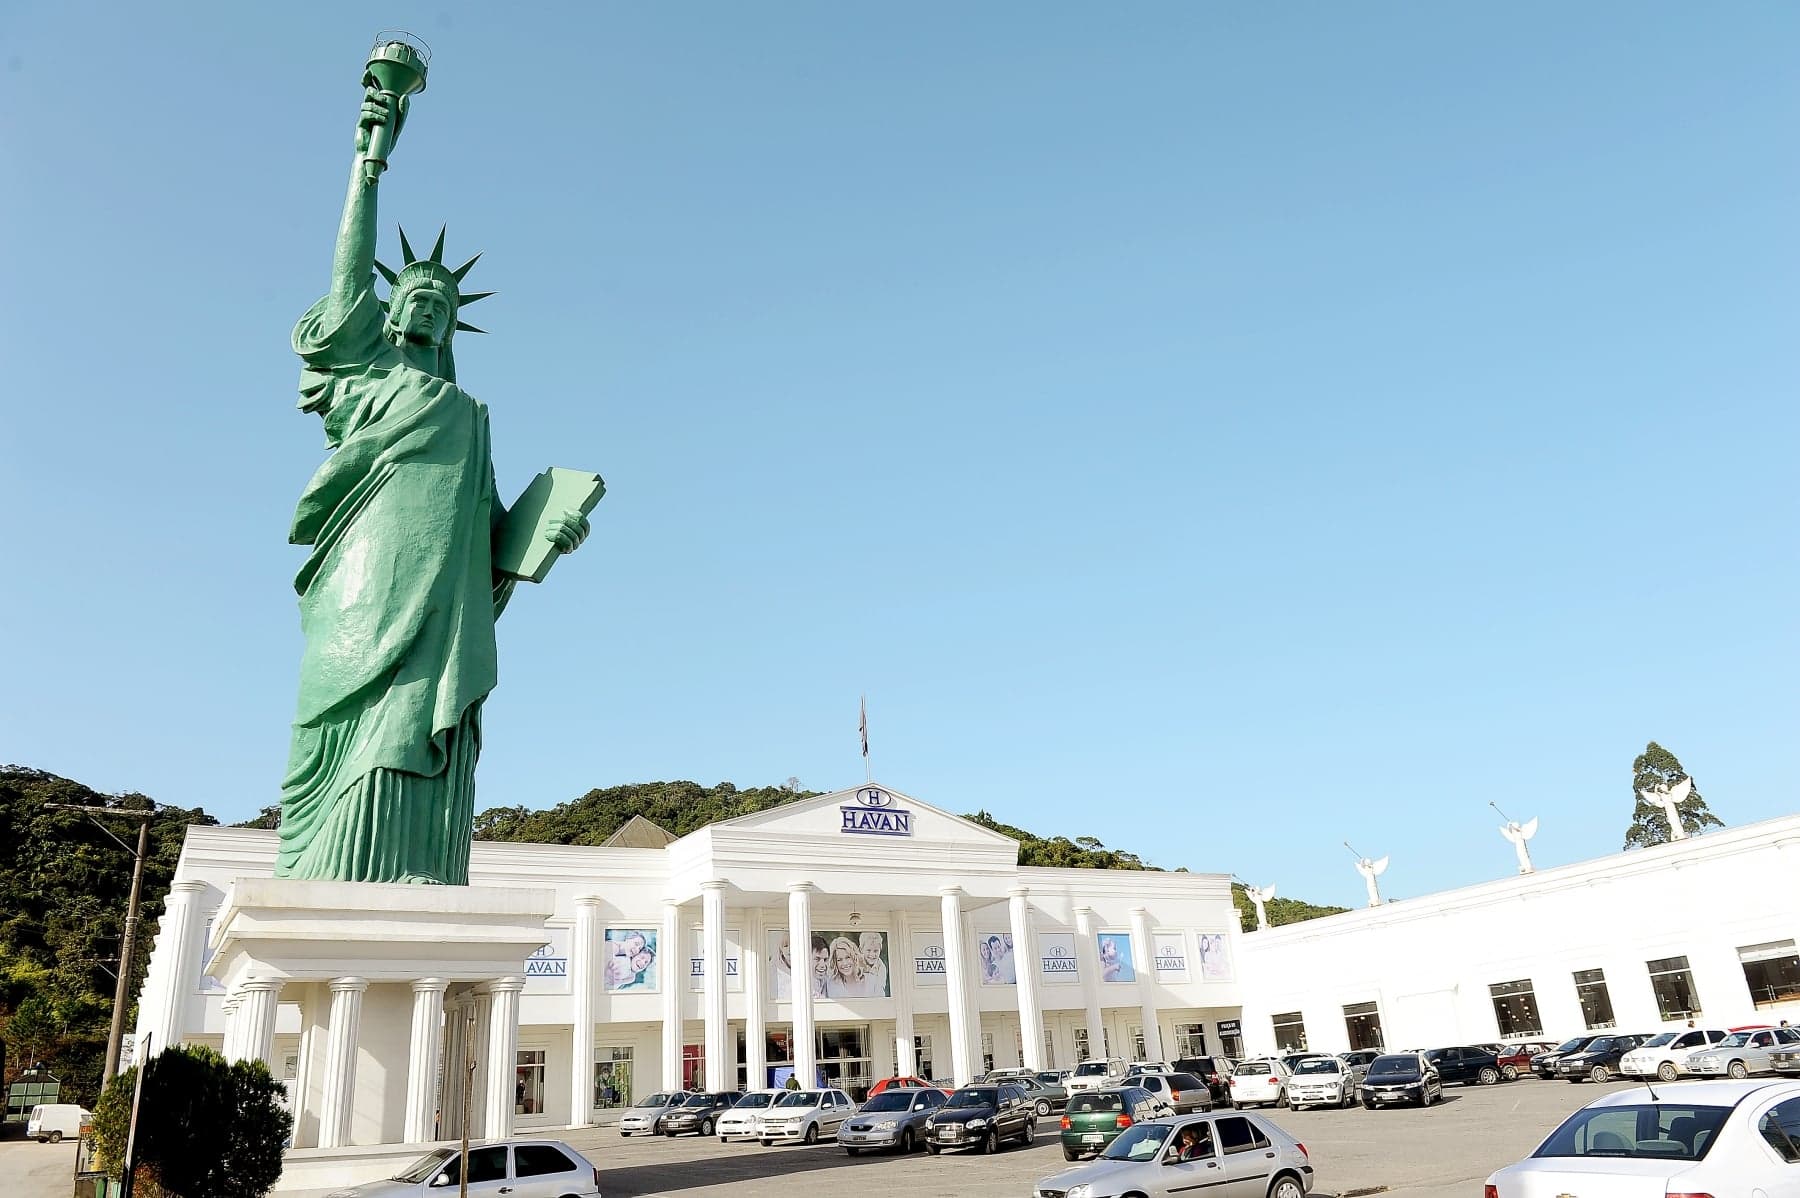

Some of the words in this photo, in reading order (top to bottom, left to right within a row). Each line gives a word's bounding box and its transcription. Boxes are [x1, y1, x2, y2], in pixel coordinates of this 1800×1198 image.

[868, 790, 880, 805] H
[841, 810, 910, 832] HAVAN
[929, 947, 938, 956] H
[1055, 947, 1062, 956] H
[1165, 947, 1172, 956] H
[527, 961, 566, 974] AVAN
[915, 960, 945, 971] HAVA
[1043, 959, 1076, 970] HAVAN
[1155, 958, 1185, 969] HAVAN
